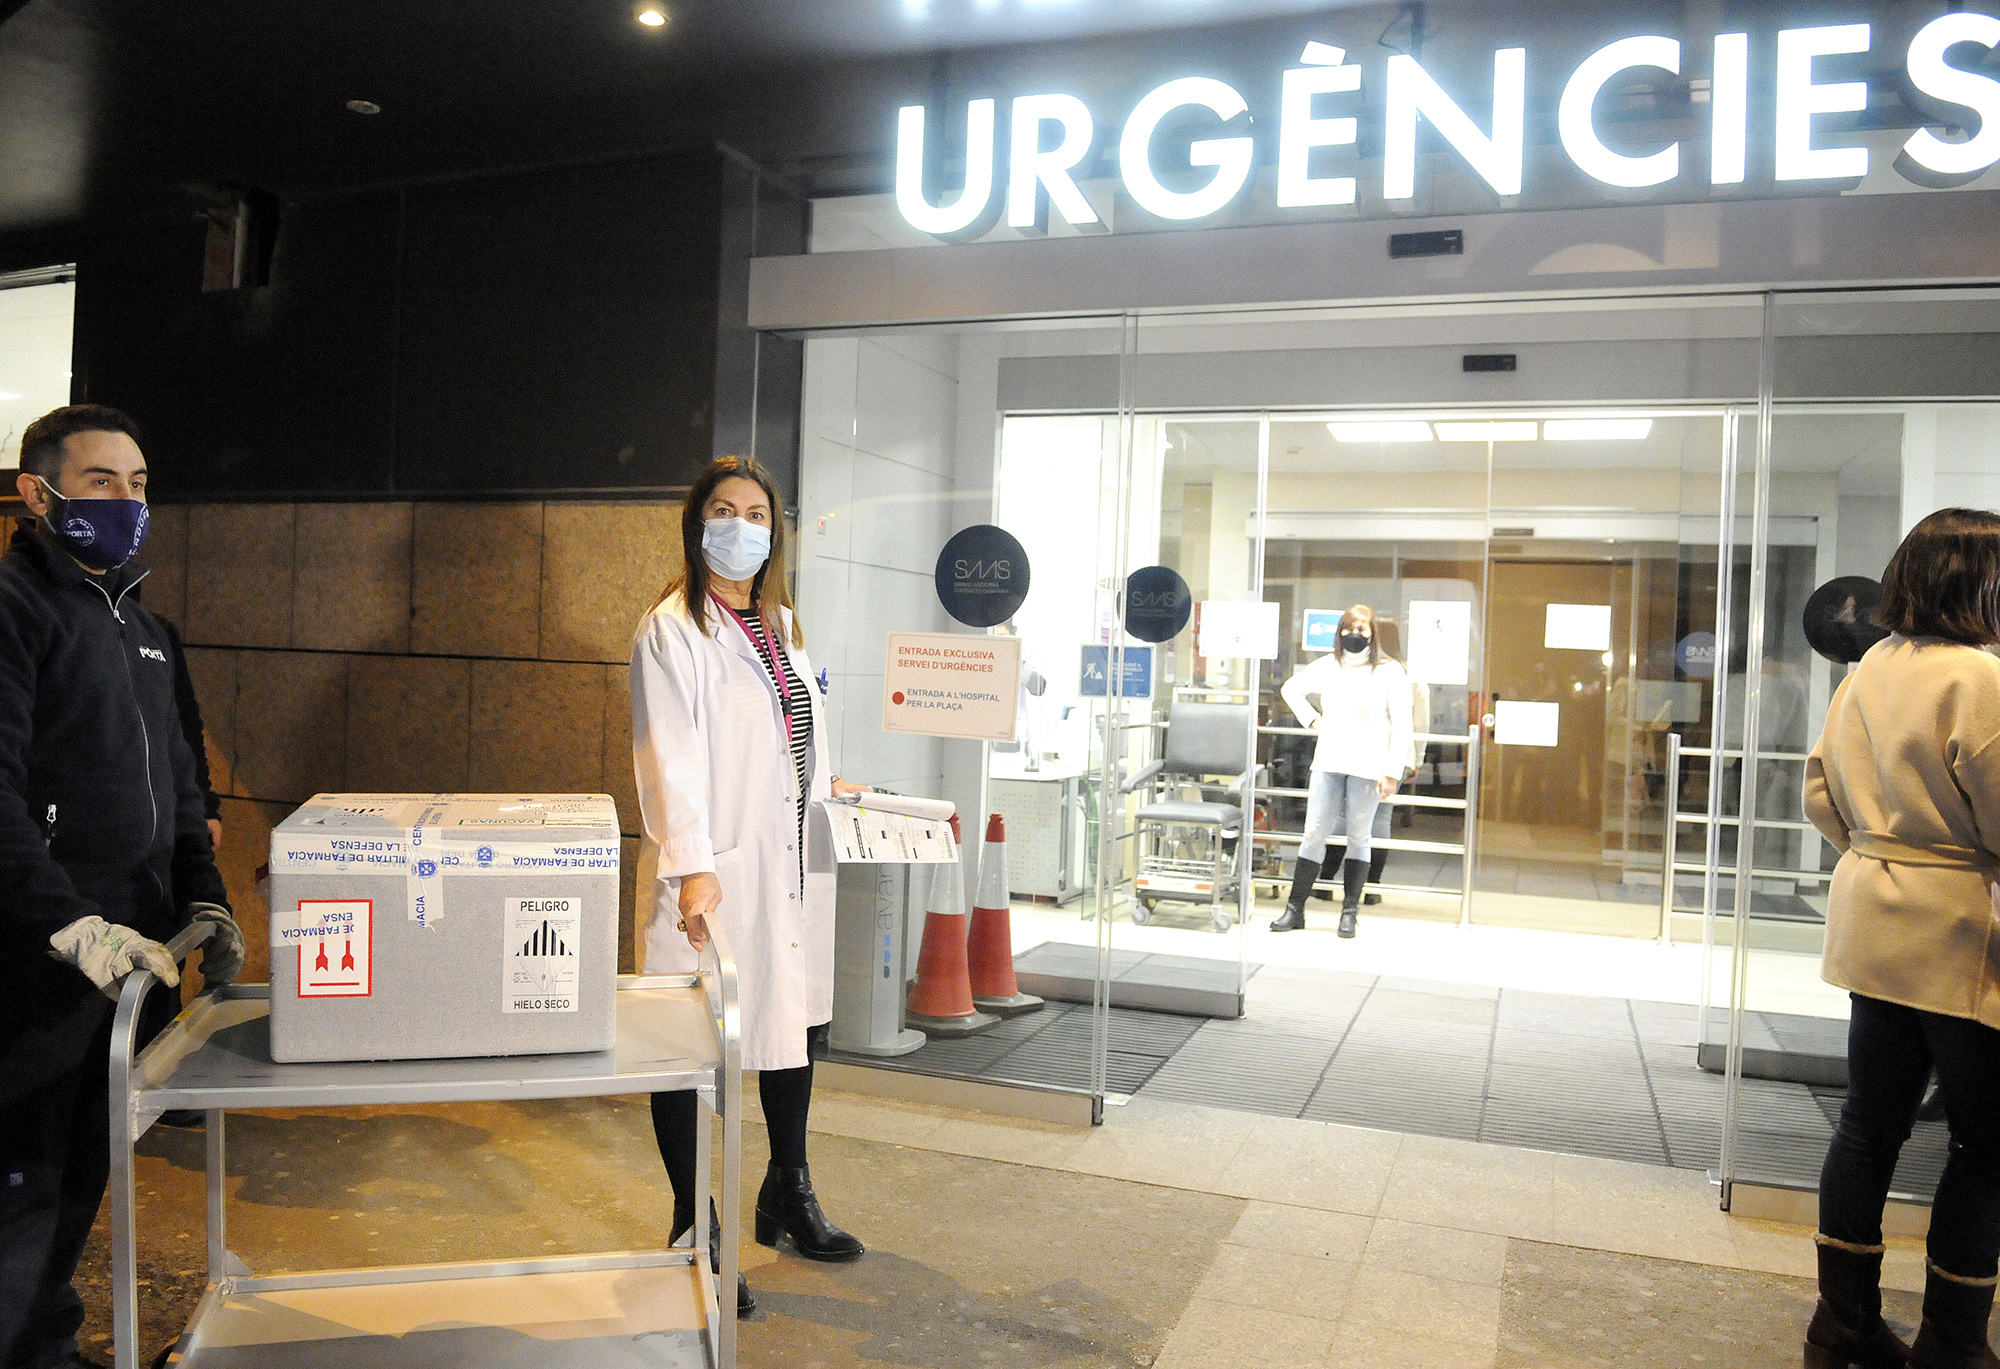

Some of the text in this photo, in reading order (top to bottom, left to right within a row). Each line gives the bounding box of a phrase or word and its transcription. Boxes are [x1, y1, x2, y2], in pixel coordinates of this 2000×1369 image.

[895, 12, 2000, 236] URGÈNCIES
[954, 559, 1011, 579] SAAS
[139, 646, 166, 662] PORTA
[898, 646, 995, 660] ENTRADA EXCLUSIVA
[897, 659, 994, 673] SERVEI D'URGÈNCIES
[907, 688, 944, 698] ENTRADA
[954, 692, 1000, 702] L'HOSPITAL
[906, 700, 963, 711] PER LA PLAÇA
[330, 840, 400, 852] LA DEFENSA
[553, 846, 619, 856] LA DEFENSA
[287, 850, 345, 862] FARMACIA
[348, 852, 364, 862] DE
[512, 856, 568, 867] FARMACIA
[571, 857, 585, 867] DE
[520, 900, 570, 912] PELIGRO
[322, 912, 353, 923] ENSA
[281, 924, 340, 938] FARMACIA
[513, 999, 570, 1010] HIELO SECO
